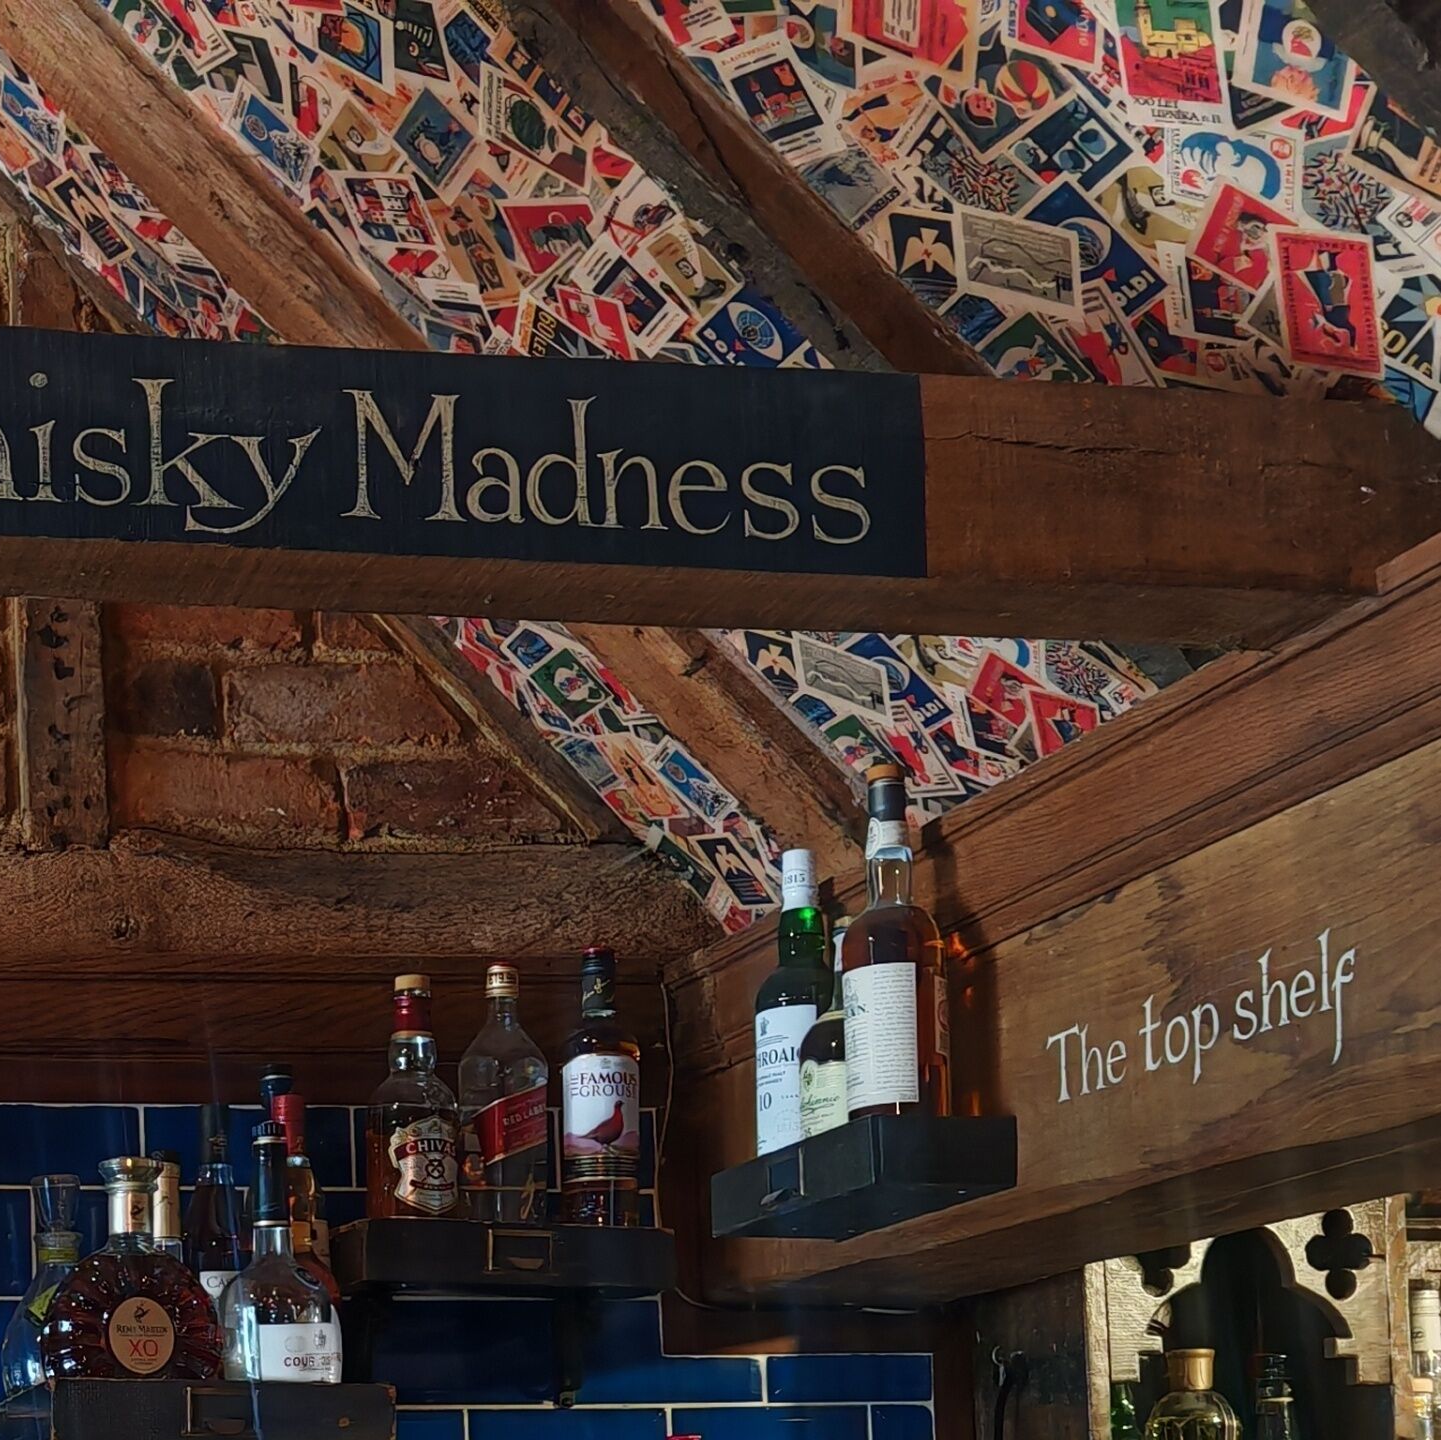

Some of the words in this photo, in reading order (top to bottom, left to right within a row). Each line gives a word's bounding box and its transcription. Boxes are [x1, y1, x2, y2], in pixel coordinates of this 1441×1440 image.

[339, 387, 872, 546] Madness
[1046, 1022, 1127, 1104] The
[1138, 994, 1220, 1086] top
[1233, 927, 1356, 1067] shelf
[579, 1070, 637, 1087] FAMOUS
[128, 1338, 160, 1358] XO
